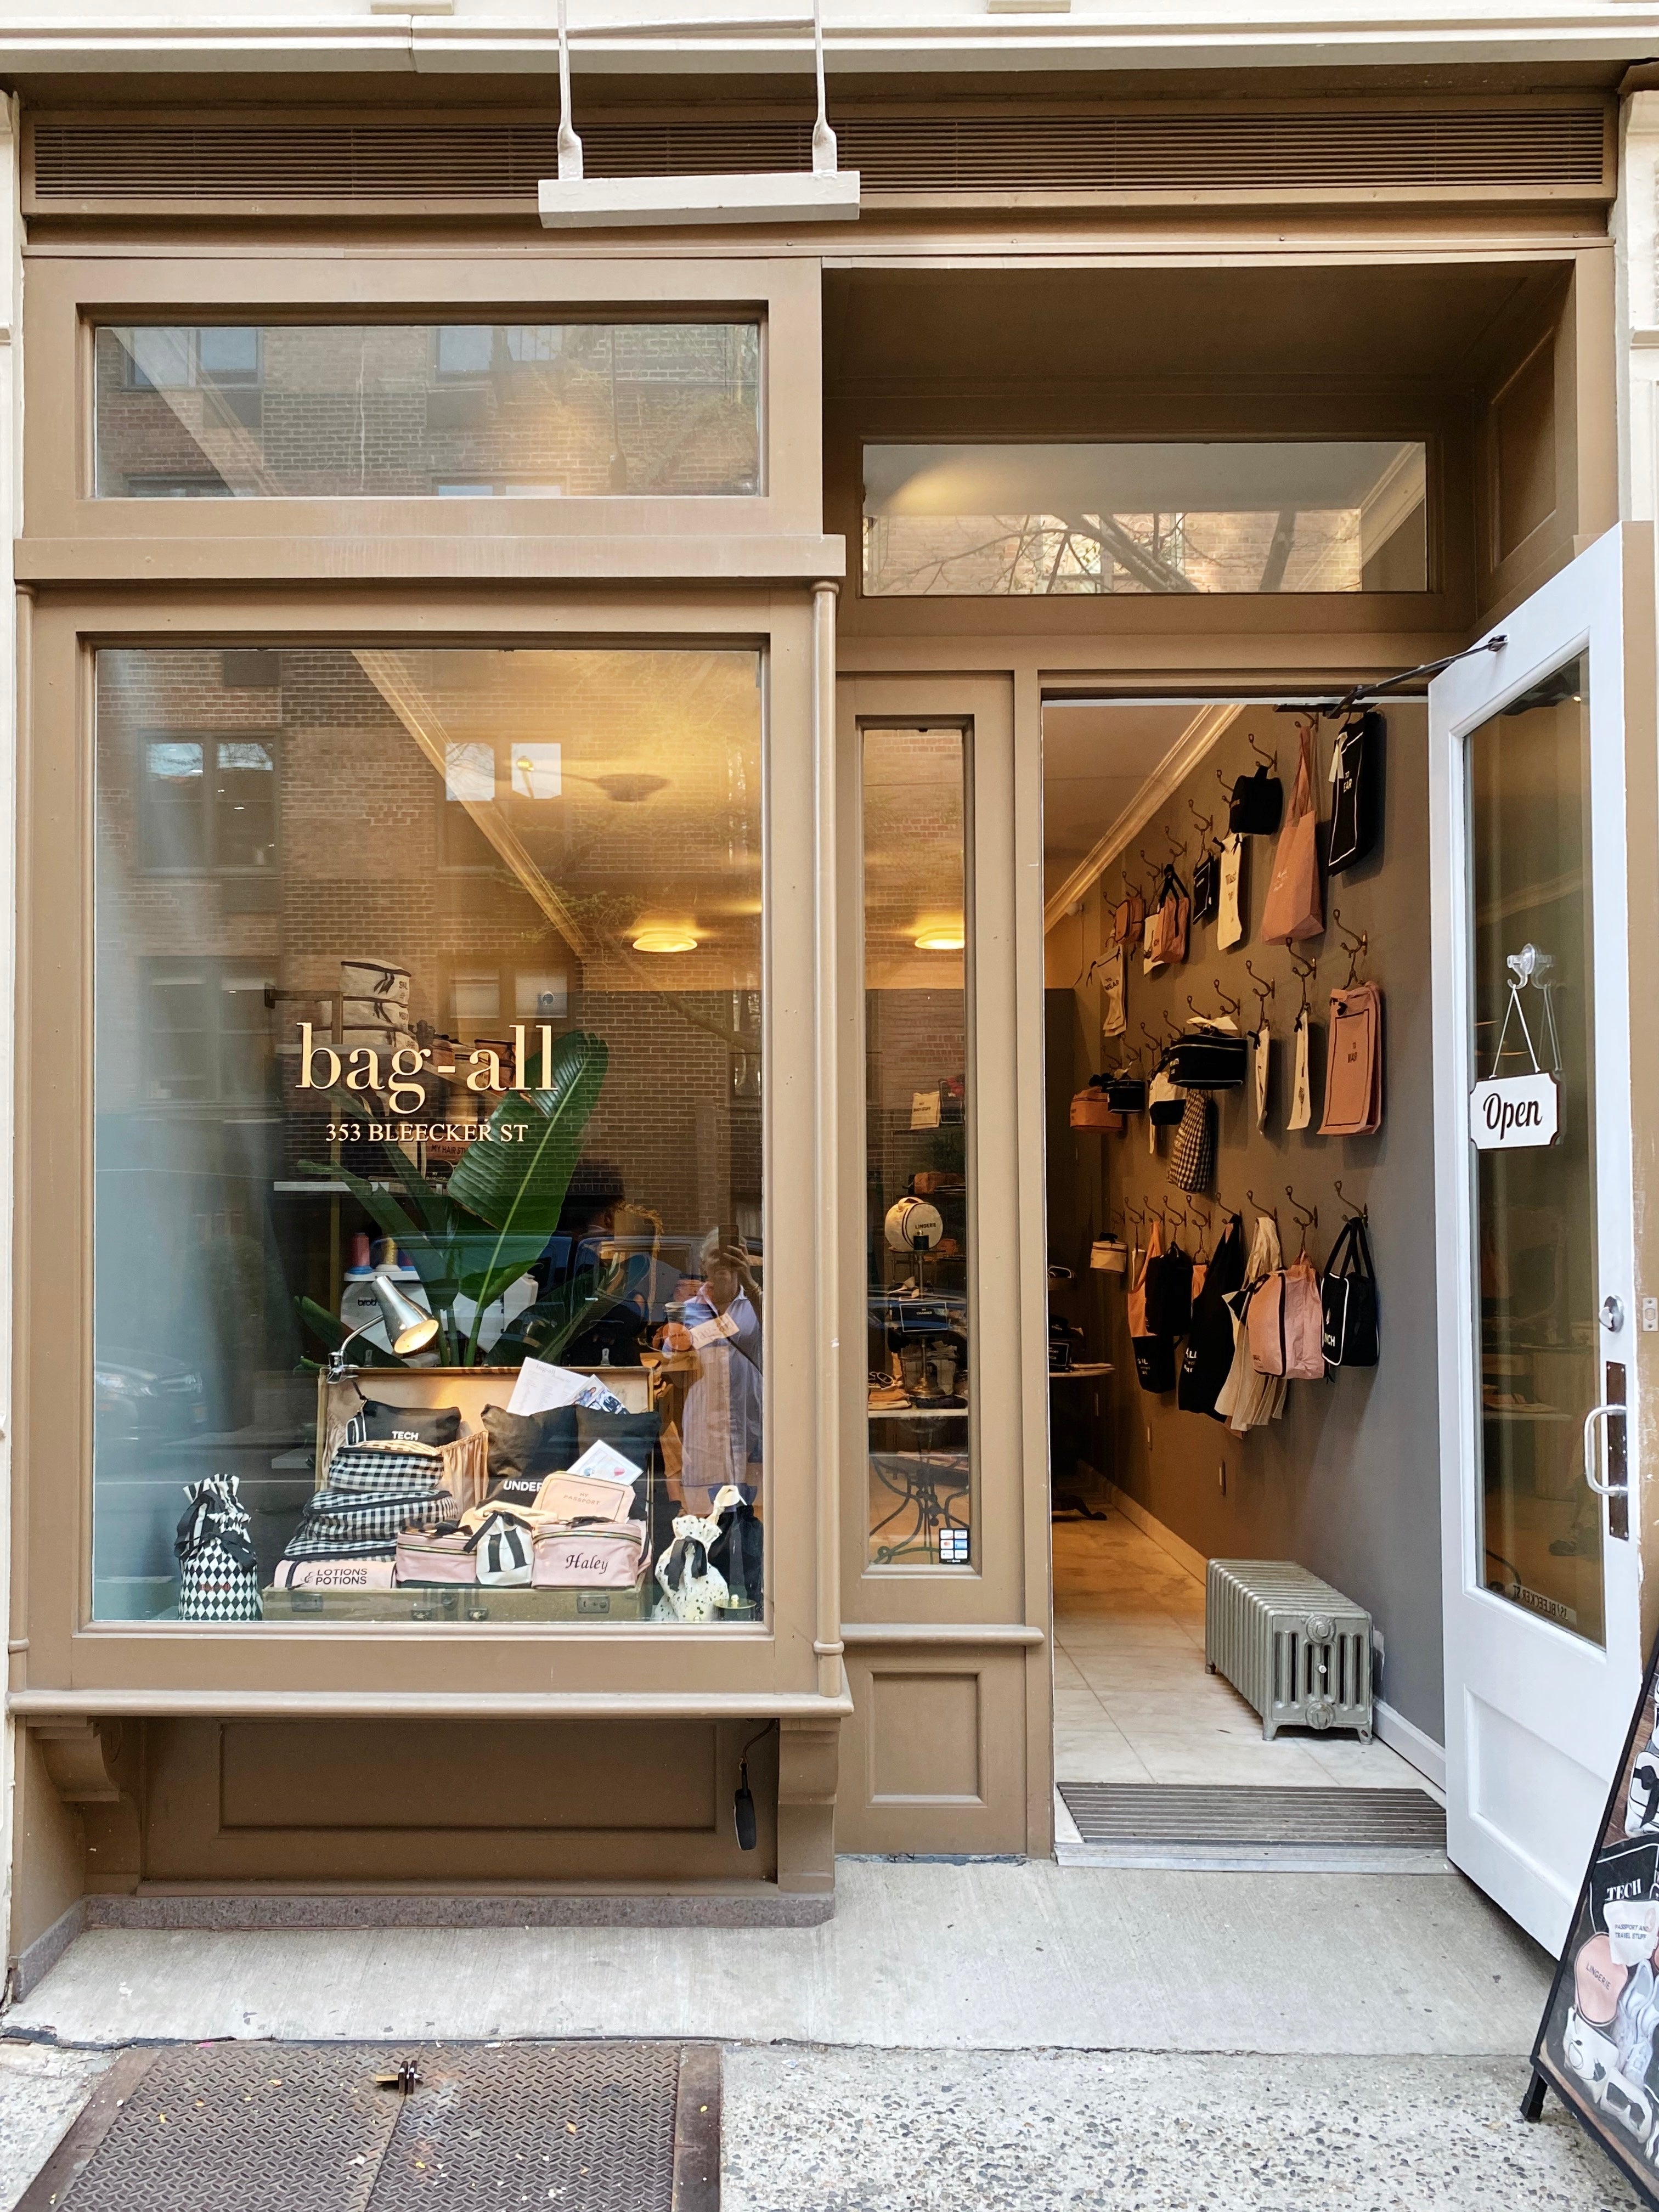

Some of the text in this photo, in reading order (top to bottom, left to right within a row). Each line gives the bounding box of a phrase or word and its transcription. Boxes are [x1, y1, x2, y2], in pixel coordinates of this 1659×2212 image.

[1104, 979, 1119, 991] WEAR
[295, 1022, 559, 1114] bag-all
[1483, 1093, 1543, 1141] Open
[325, 1124, 528, 1142] 353 BLEECKER ST
[442, 1146, 456, 1154] HAIR
[392, 1431, 419, 1441] TECH
[563, 1494, 601, 1505] PASSPORT
[565, 1552, 609, 1575] Haley
[317, 1568, 368, 1576] LOTIONS
[315, 1576, 367, 1585] POTIONS
[1607, 1878, 1641, 1900] TECH
[1586, 1962, 1611, 1990] LINGERIE
